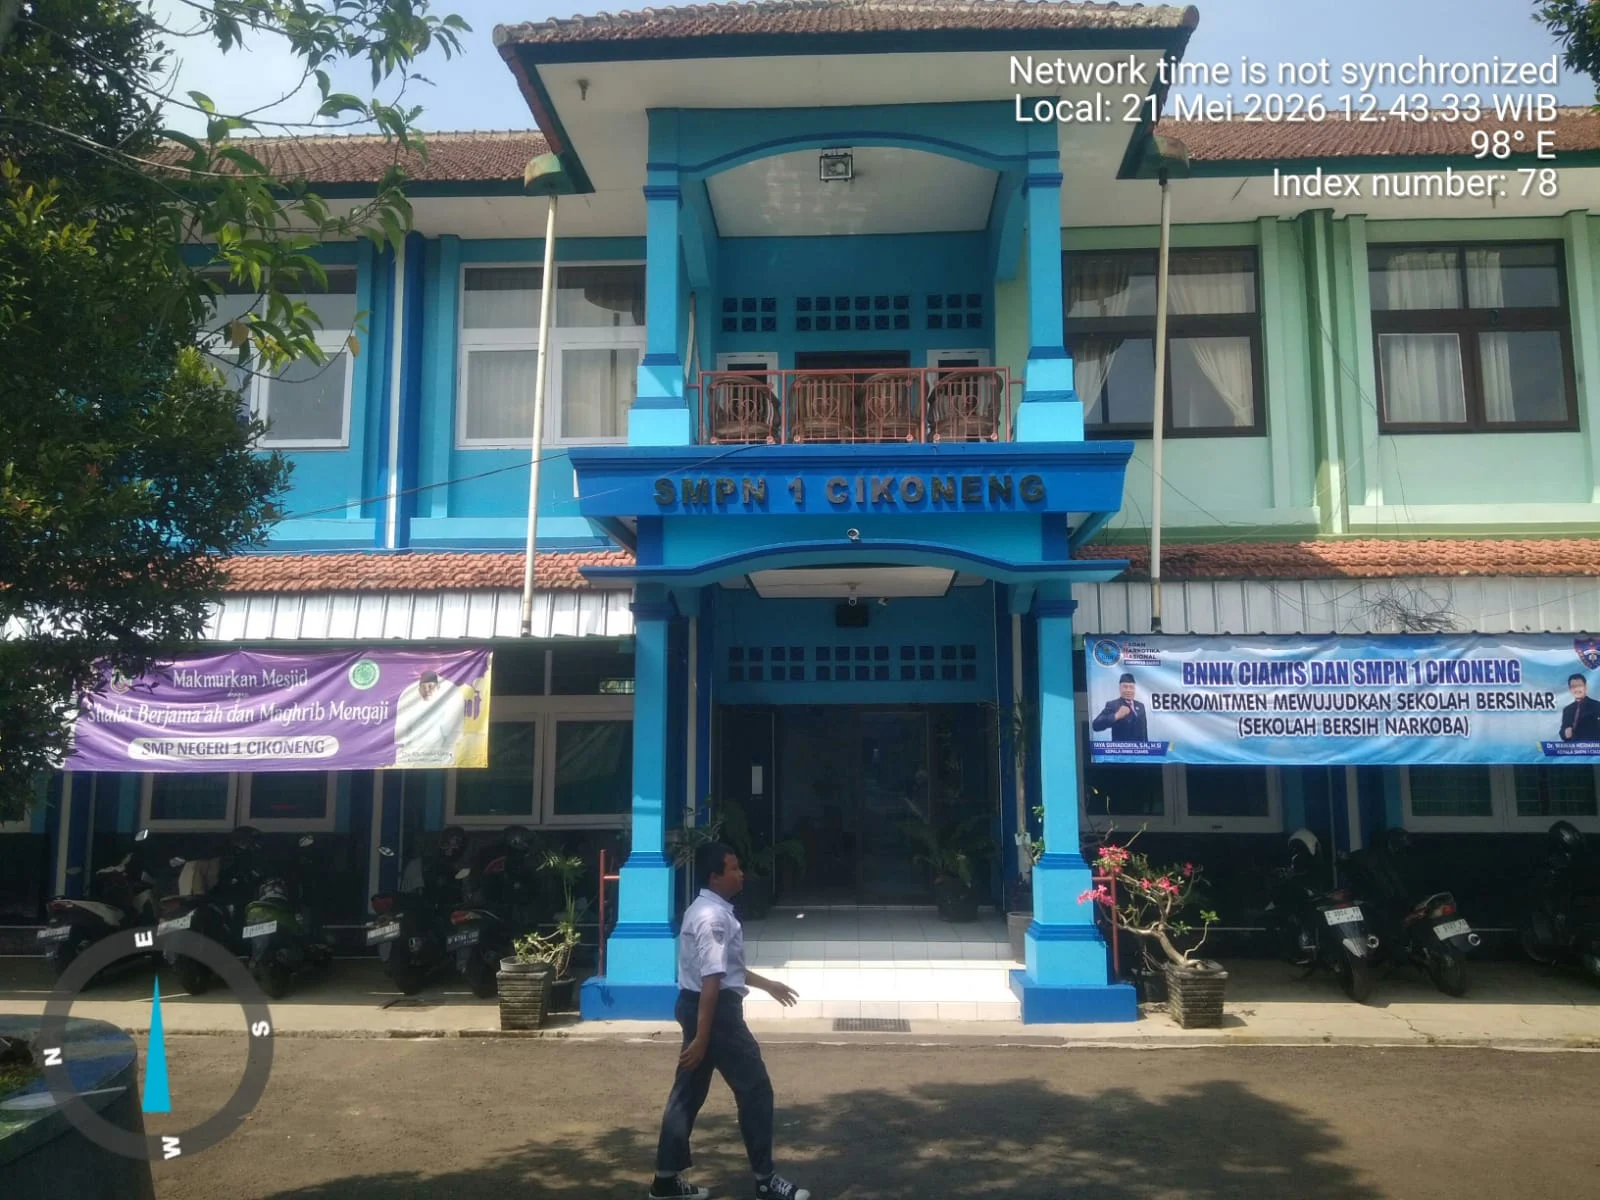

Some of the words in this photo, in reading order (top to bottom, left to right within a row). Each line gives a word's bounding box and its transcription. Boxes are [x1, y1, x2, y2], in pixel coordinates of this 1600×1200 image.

[653, 477, 768, 505] SMPN
[788, 477, 804, 503] 1
[825, 475, 1046, 503] CIKONENG
[172, 669, 258, 689] Makmurkan
[261, 668, 309, 690] Mesjid
[1183, 662, 1234, 685] BNNK
[1239, 661, 1307, 685] CIAMIS
[1311, 661, 1349, 685] DAN
[1353, 660, 1408, 685] SMPN
[1411, 661, 1422, 684] 1
[1425, 660, 1520, 684] CIKONENG
[1152, 694, 1267, 711] BERKOMITMEN
[1274, 693, 1391, 711] MEWUJUDKAN
[1397, 692, 1470, 710] SEKOLAH
[1476, 691, 1556, 710] BERSINAR
[87, 703, 133, 723] Shalat
[227, 701, 254, 723] dan
[260, 702, 325, 727] Maghrib
[329, 701, 389, 725] Mengaji
[1238, 717, 1316, 737] (SEKOLAH
[1323, 717, 1379, 736] BERSIH
[1385, 715, 1469, 736] NARKOBA)
[142, 742, 174, 756] SMP
[178, 742, 229, 755] NEGERI
[231, 742, 242, 755] 1
[246, 740, 325, 755] CIKONENG
